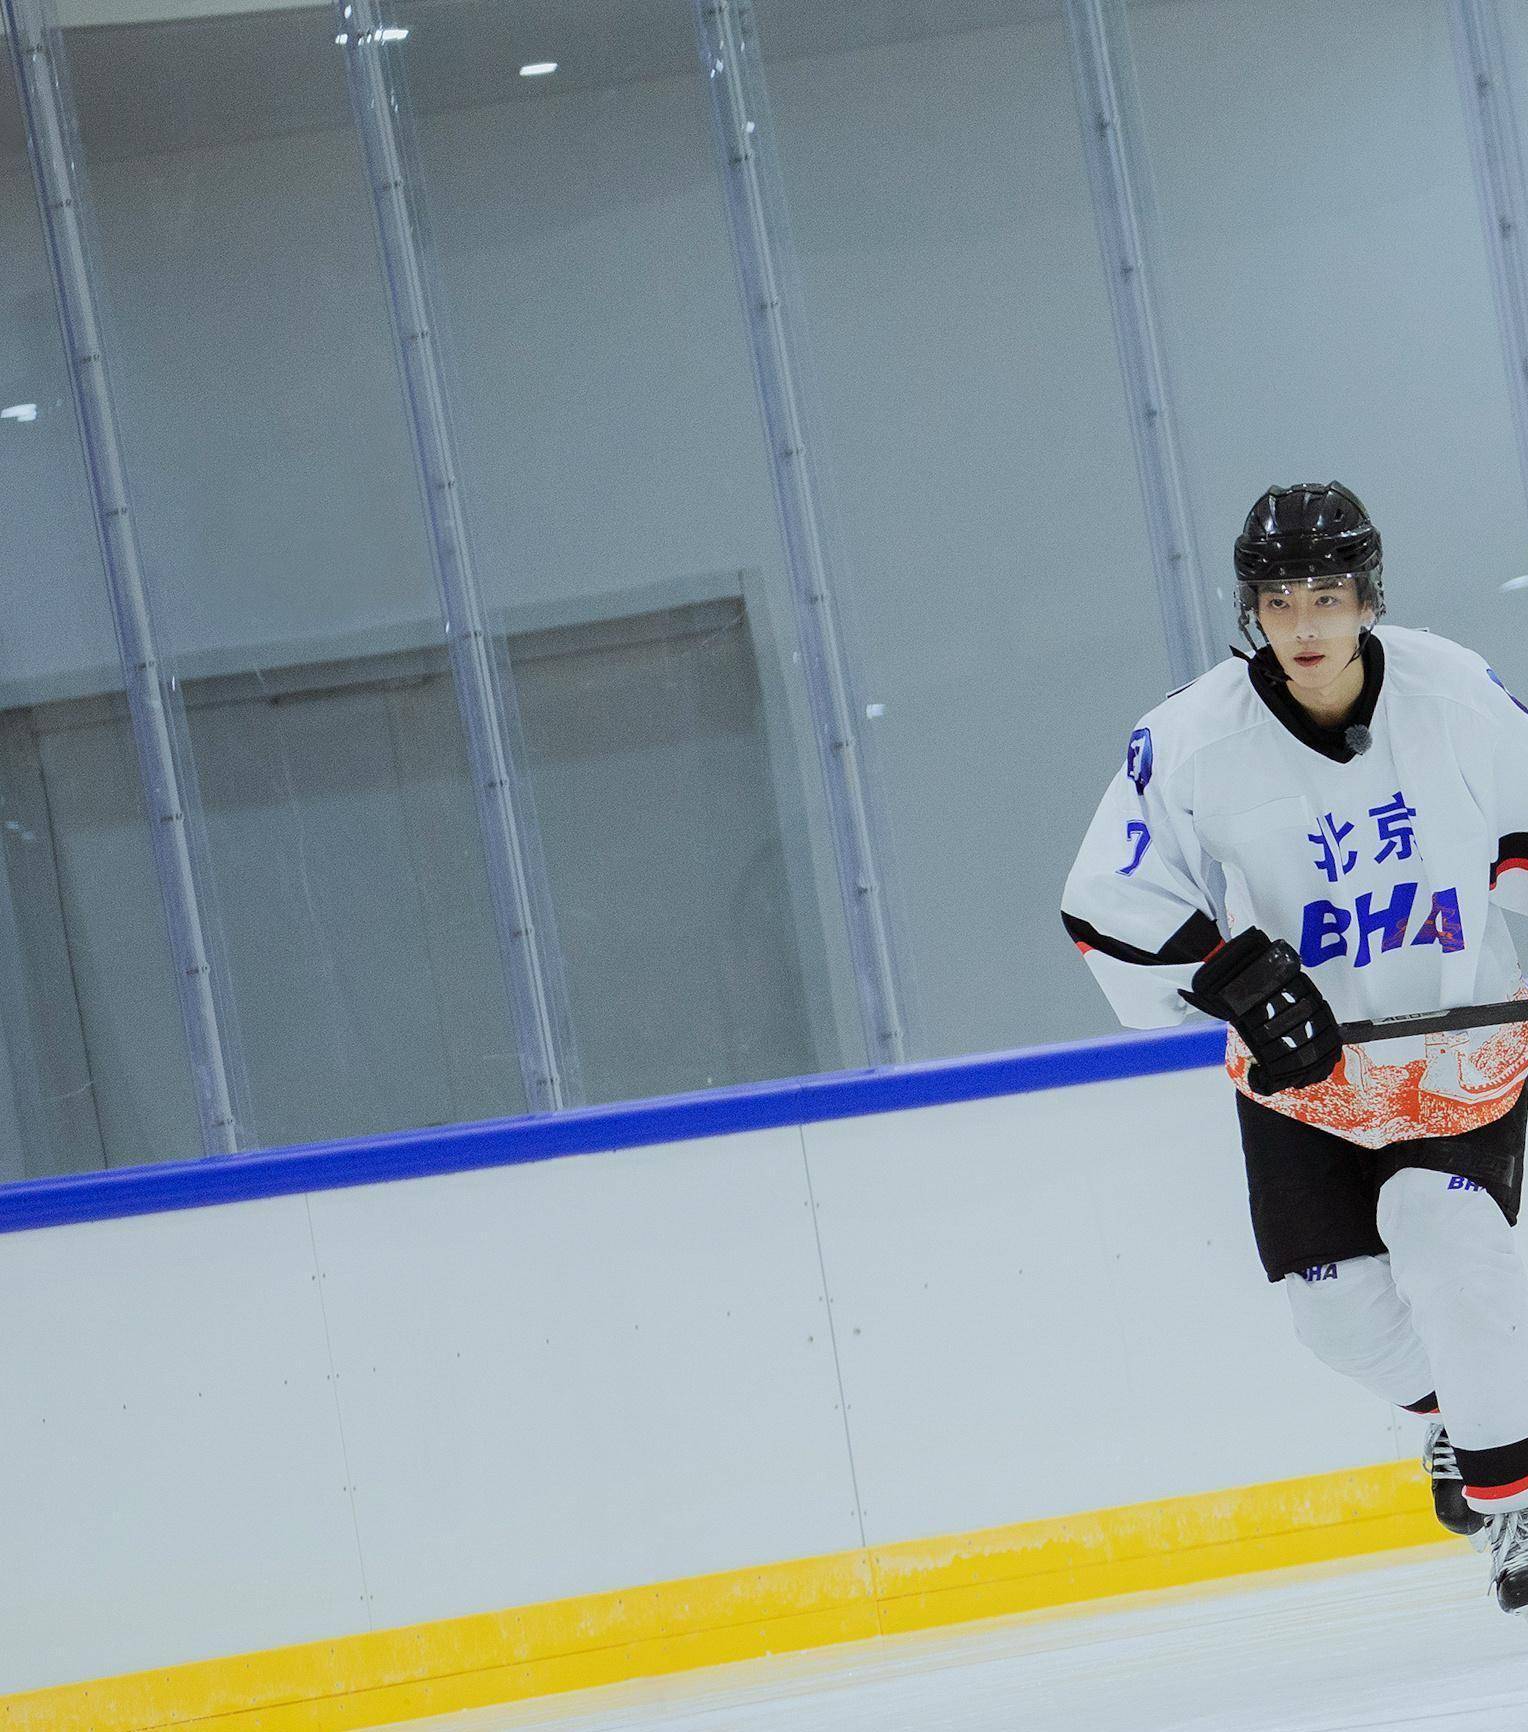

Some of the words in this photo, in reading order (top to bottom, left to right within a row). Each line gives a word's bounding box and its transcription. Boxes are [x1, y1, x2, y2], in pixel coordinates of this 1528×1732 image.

[1116, 820, 1152, 877] 7
[1307, 791, 1422, 882] 北京
[1299, 882, 1465, 968] BHA
[1447, 1175, 1485, 1191] BH
